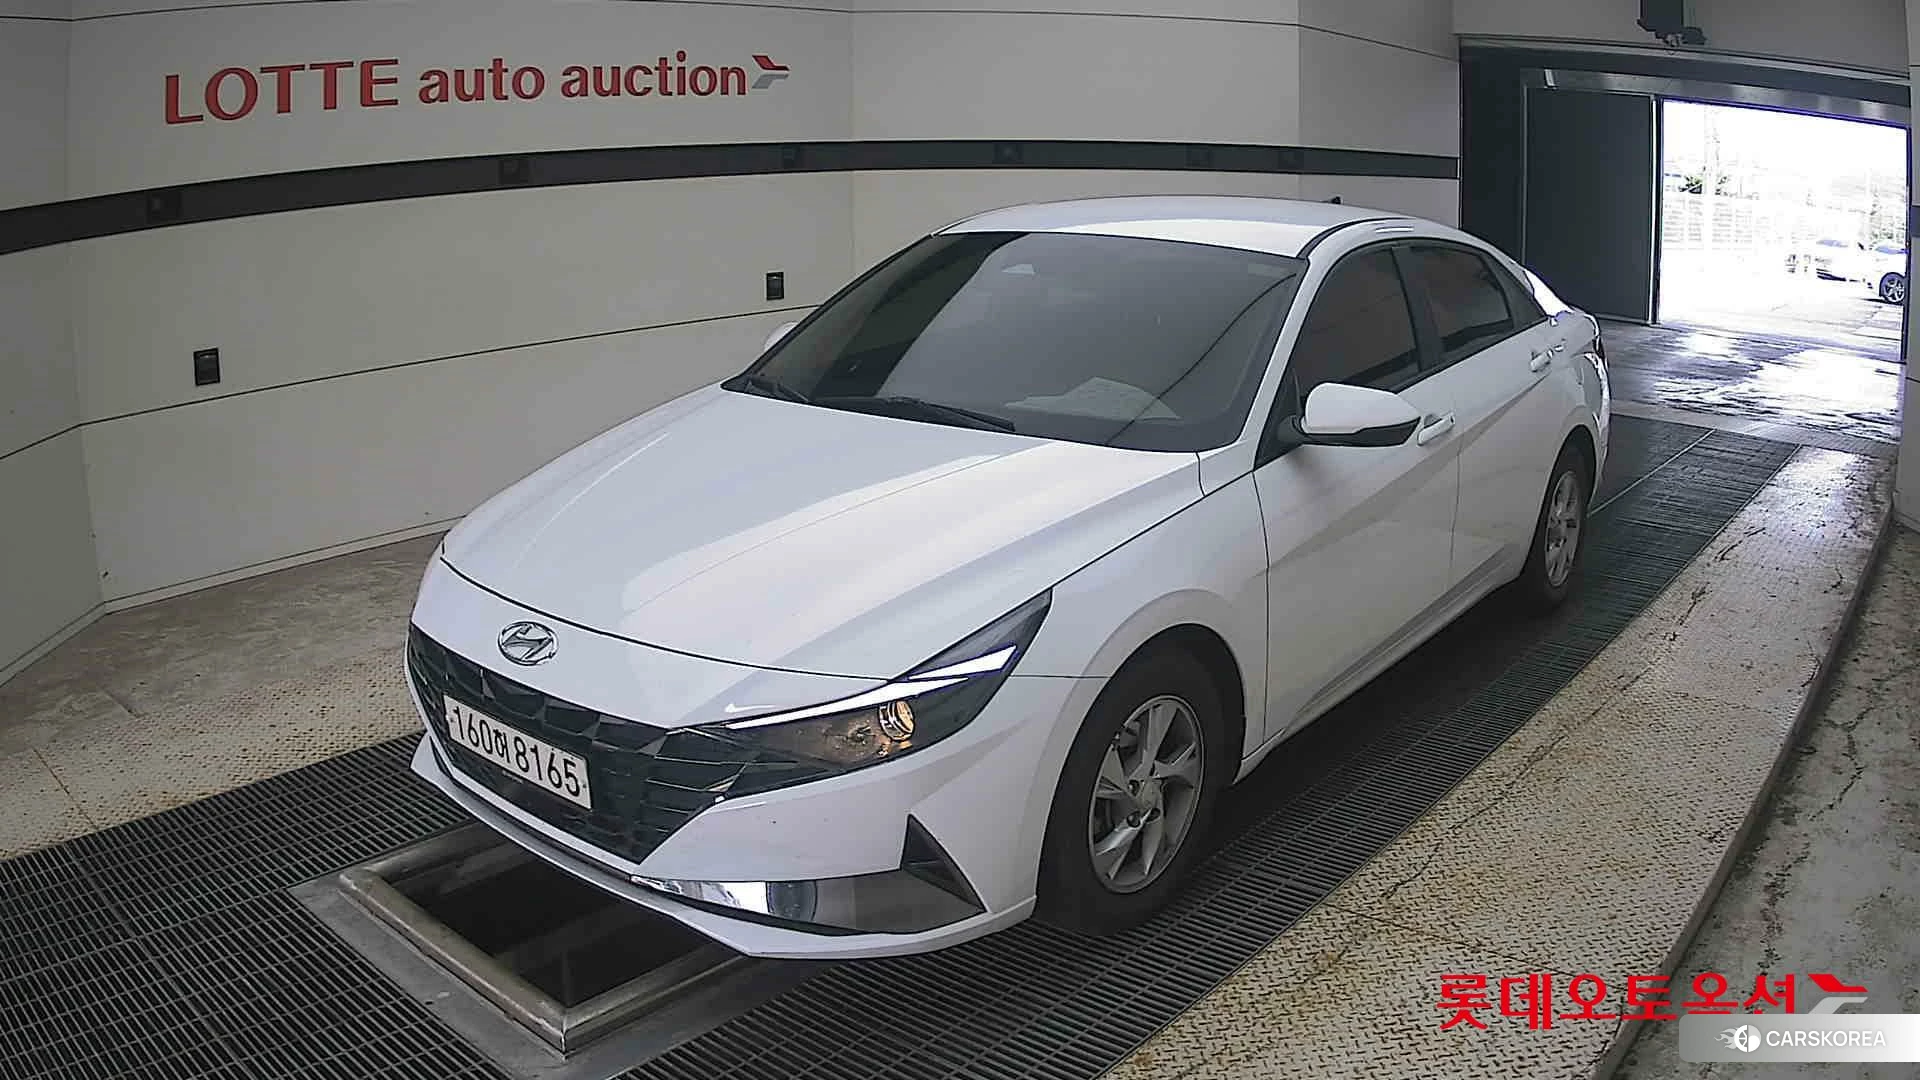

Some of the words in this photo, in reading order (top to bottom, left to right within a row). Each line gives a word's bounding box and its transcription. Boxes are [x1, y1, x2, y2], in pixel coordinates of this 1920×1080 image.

[165, 58, 399, 124] LOTTE
[418, 57, 546, 104] auto
[560, 50, 746, 99] auction
